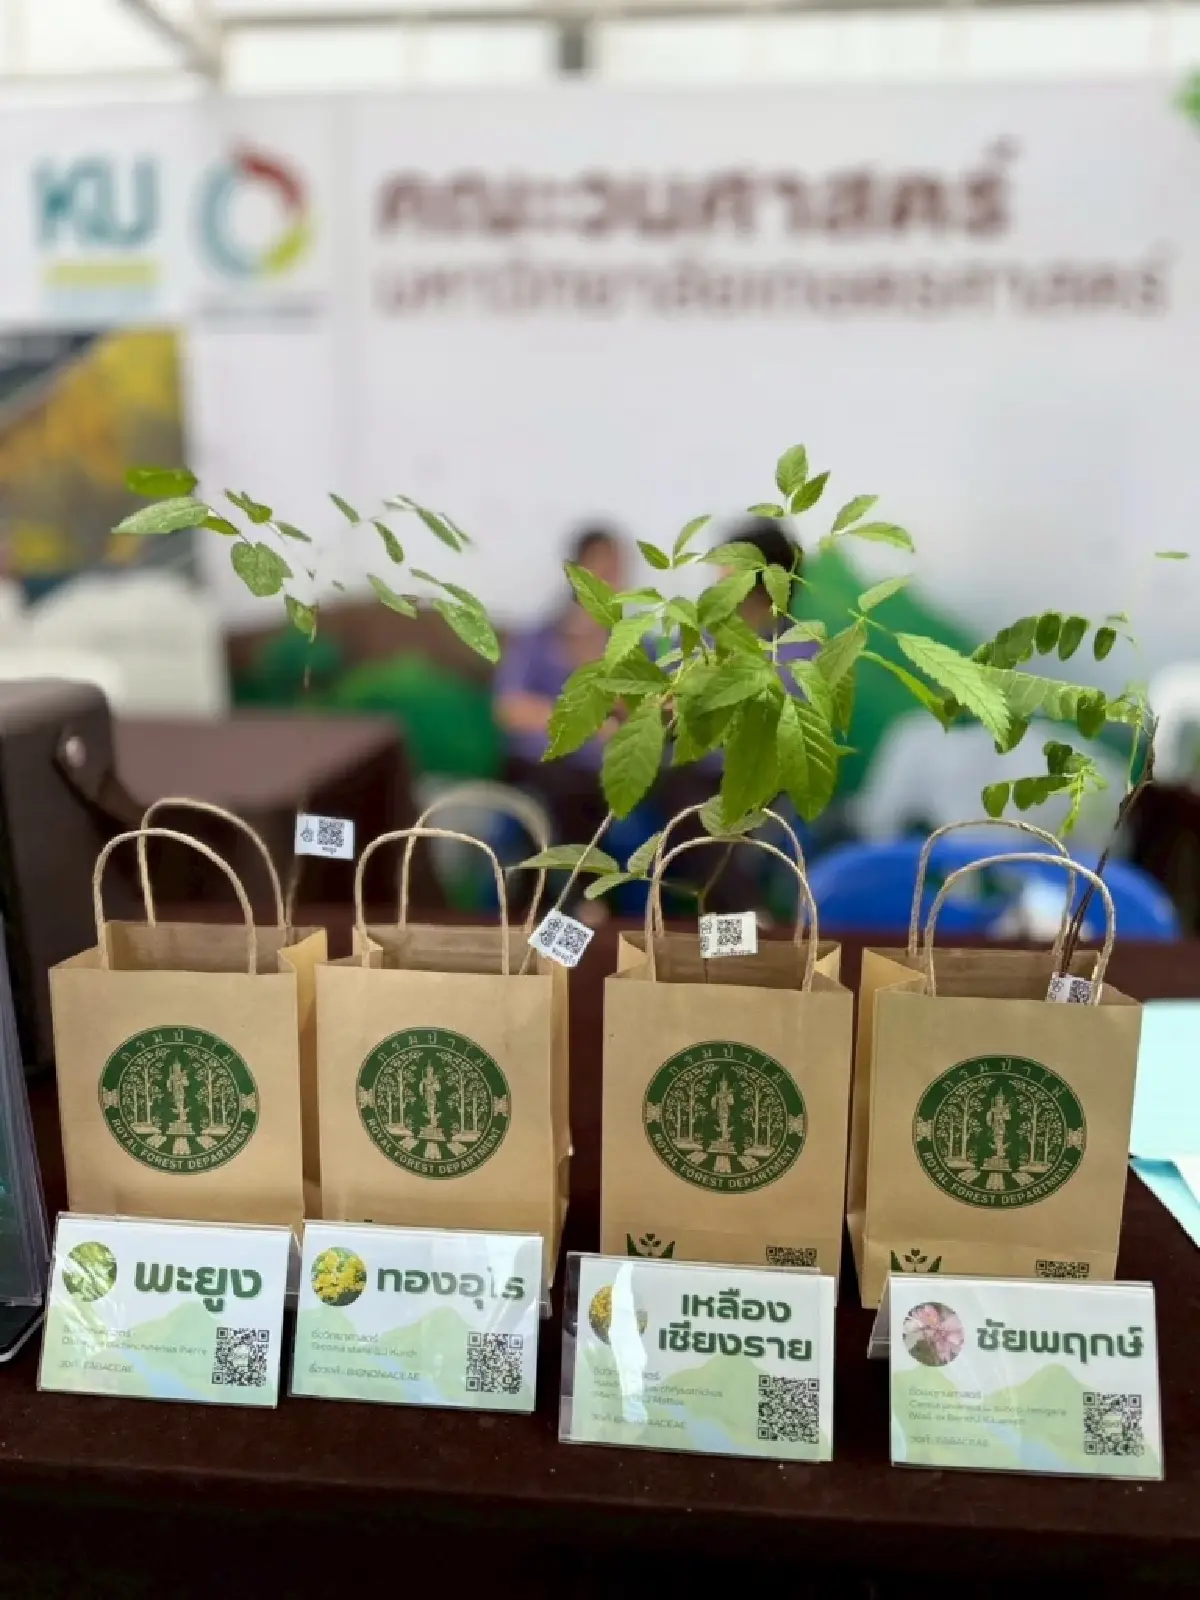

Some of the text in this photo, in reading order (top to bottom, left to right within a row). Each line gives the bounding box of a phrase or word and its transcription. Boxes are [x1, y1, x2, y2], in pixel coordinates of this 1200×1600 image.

[35, 152, 160, 248] KU
[112, 1119, 250, 1170] ROYAL FOREST DEPARTMENT
[367, 1118, 501, 1174] ROYAL FOREST DEPARTMENT
[653, 1133, 795, 1188] ROYAL FOREST DEPARTMENT
[922, 1151, 1073, 1205] ROYAL FOREST DEPARTMENT
[134, 1261, 262, 1313] พะยูง
[377, 1266, 526, 1310] ทองอุไร
[681, 1287, 792, 1323] เหลือง
[658, 1320, 812, 1362] เชียงราย
[977, 1318, 1144, 1365] ชัยพฤกษ์
